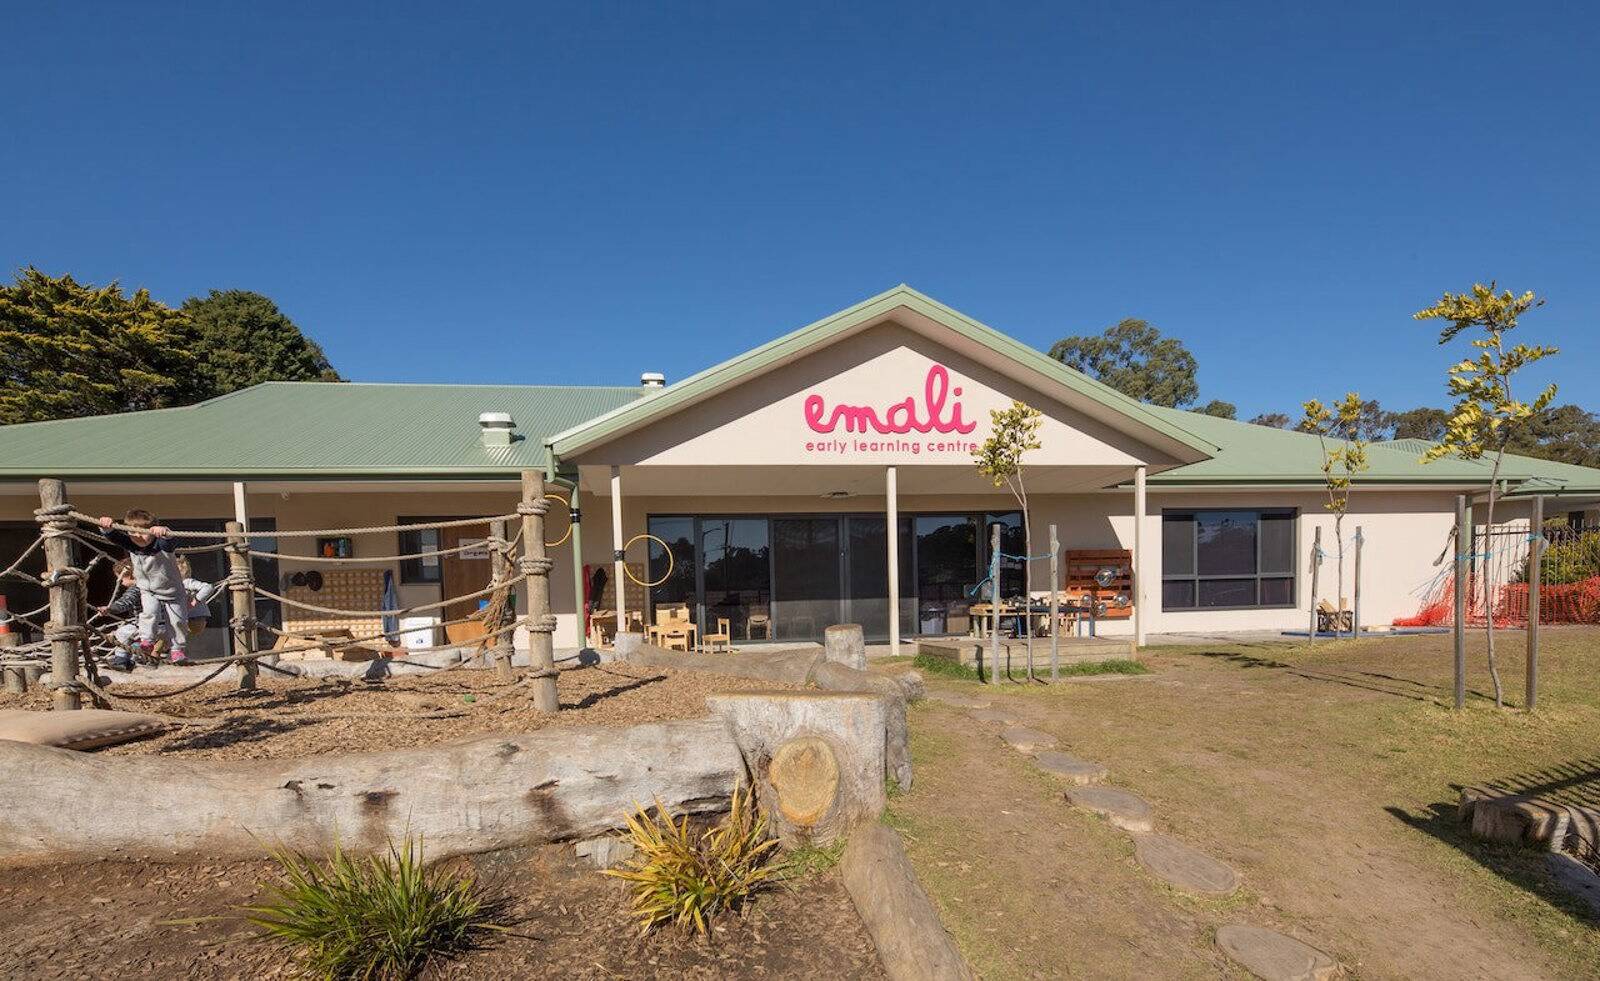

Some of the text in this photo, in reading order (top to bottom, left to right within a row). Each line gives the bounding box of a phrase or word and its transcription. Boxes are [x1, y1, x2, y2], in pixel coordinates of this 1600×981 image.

[804, 364, 977, 435] emali
[805, 440, 978, 455] early learning centre
